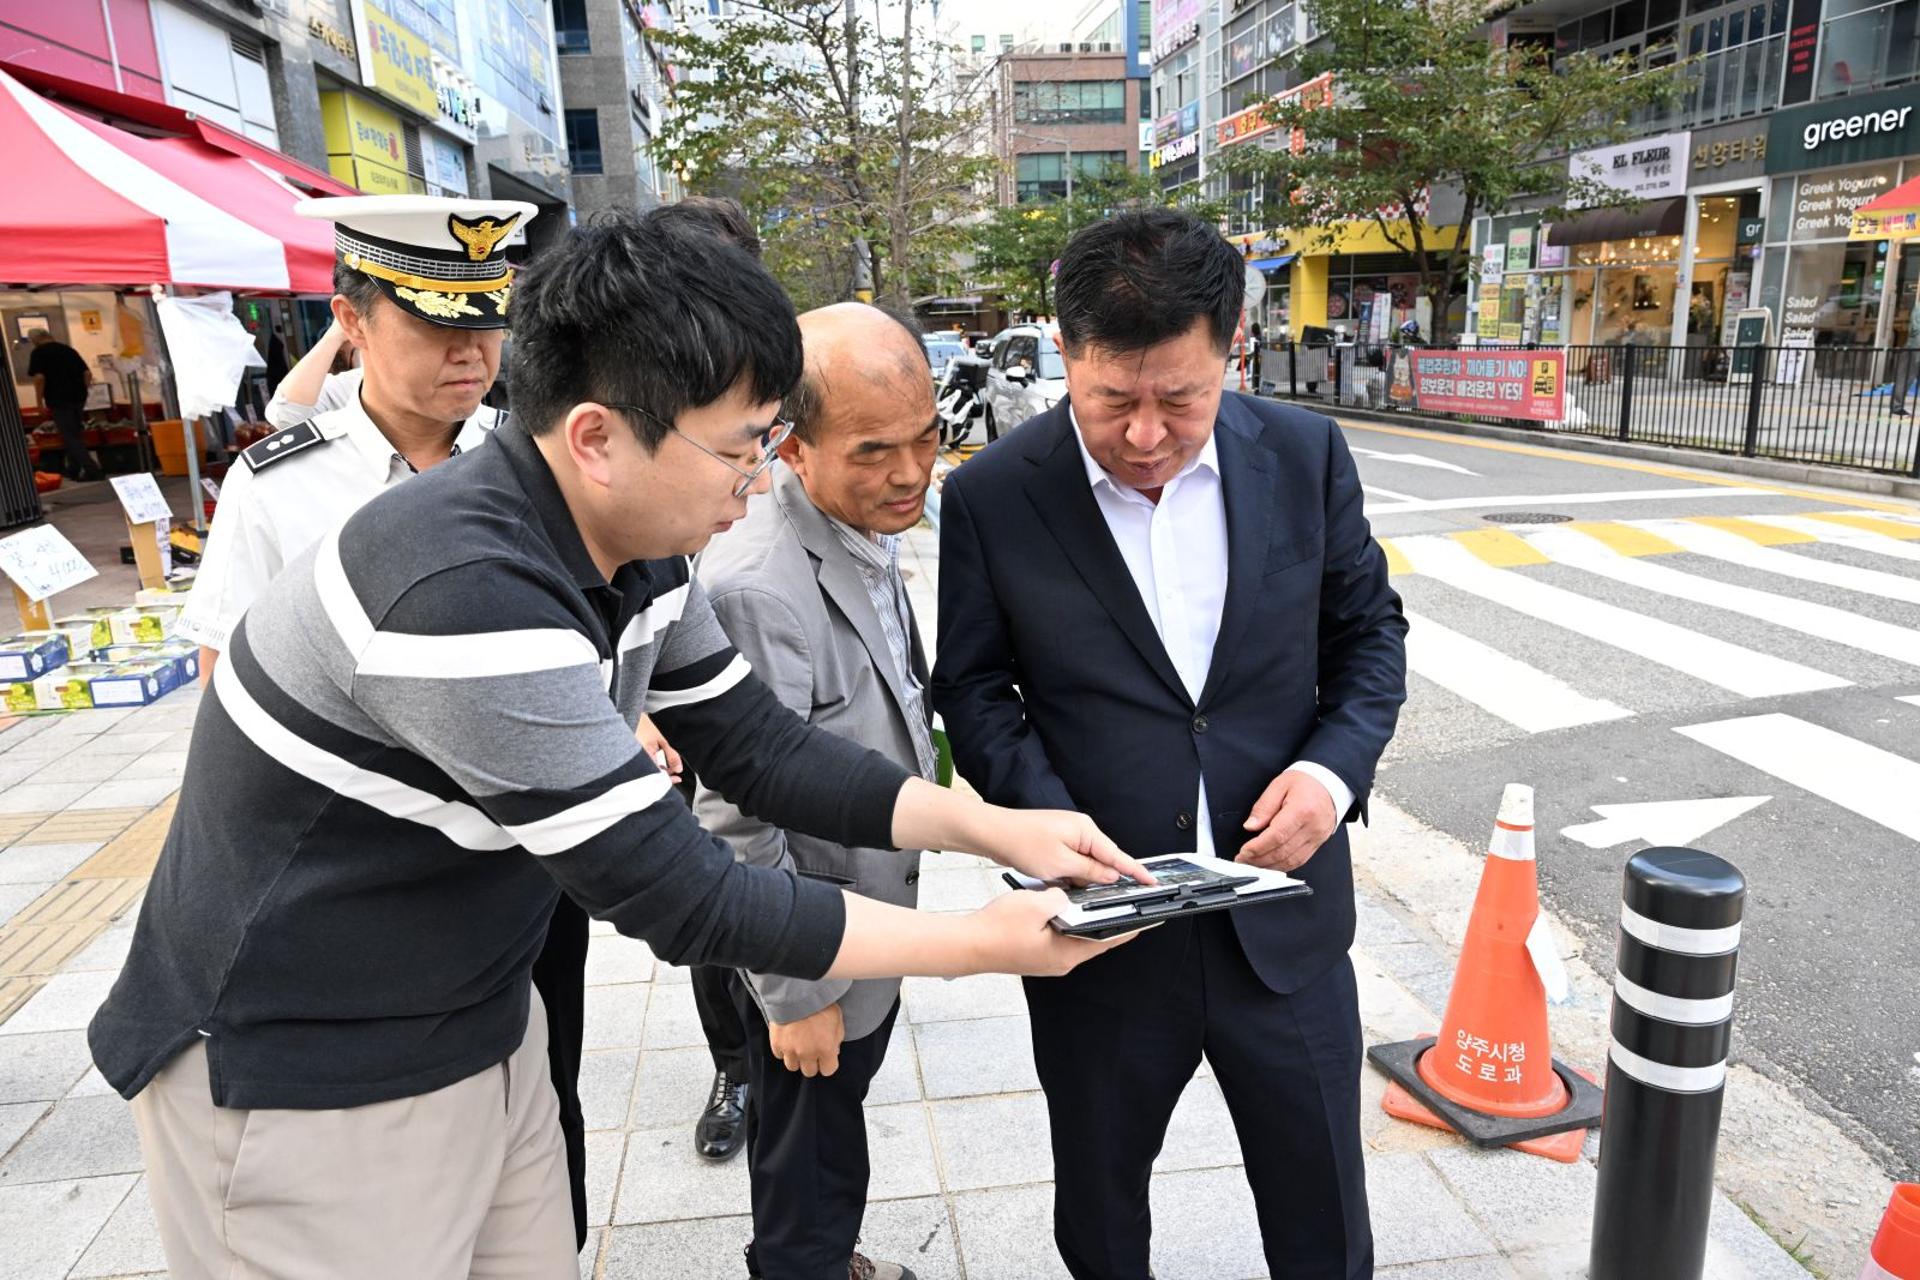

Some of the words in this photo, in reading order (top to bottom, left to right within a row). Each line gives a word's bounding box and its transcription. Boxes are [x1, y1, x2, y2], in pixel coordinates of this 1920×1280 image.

[1803, 106, 1912, 150] greener
[1613, 153, 1628, 169] EL
[1632, 146, 1671, 165] FLEUR
[1693, 135, 1766, 169] 선양타워
[1800, 180, 1835, 196] Greek
[1838, 176, 1878, 193] Yogurt
[1798, 197, 1833, 213] Greek
[1796, 215, 1831, 230] Greek
[1786, 296, 1818, 309] Salad
[1784, 311, 1816, 324] Salad
[1783, 327, 1815, 340] Salad
[1508, 360, 1528, 378] NO!
[1498, 382, 1523, 401] YES!
[1456, 1029, 1526, 1063] 양주시청
